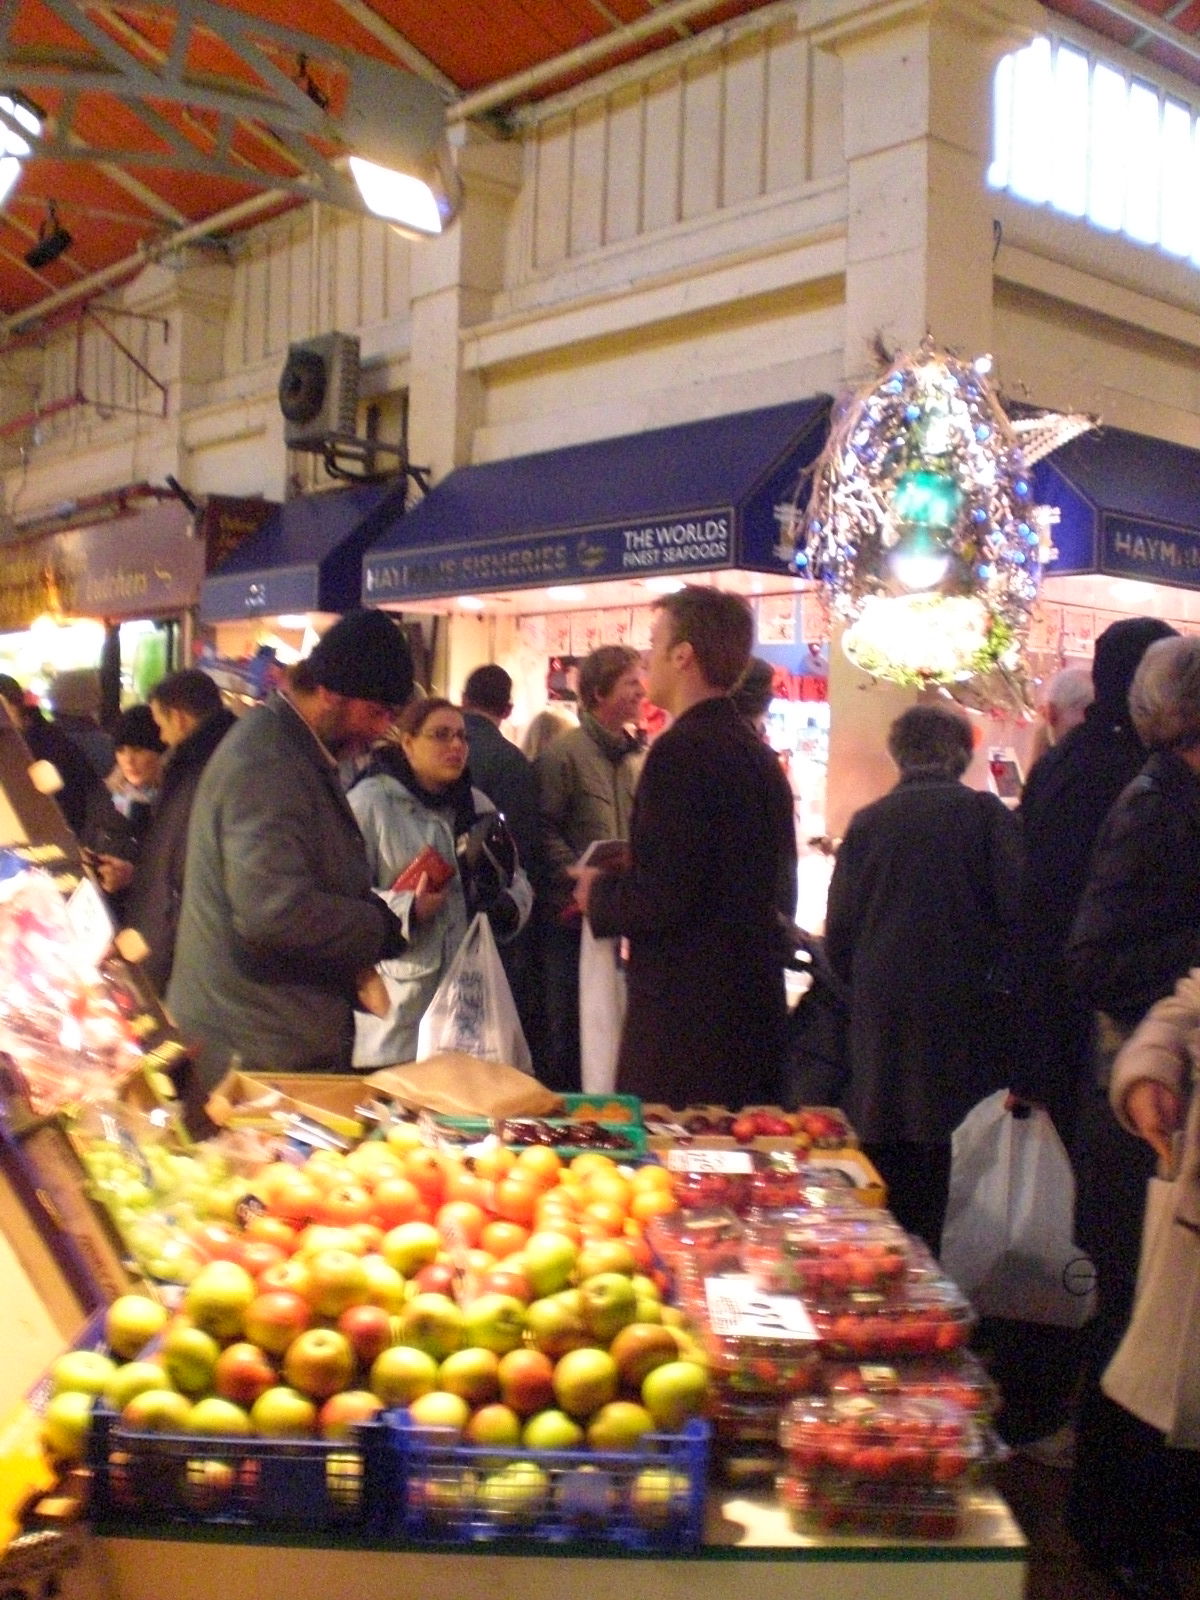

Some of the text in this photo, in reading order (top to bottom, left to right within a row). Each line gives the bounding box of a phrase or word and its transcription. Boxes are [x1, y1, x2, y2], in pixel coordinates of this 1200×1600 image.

[623, 518, 728, 550] THE WORLDS
[623, 541, 728, 567] FINEST SEAFOODS
